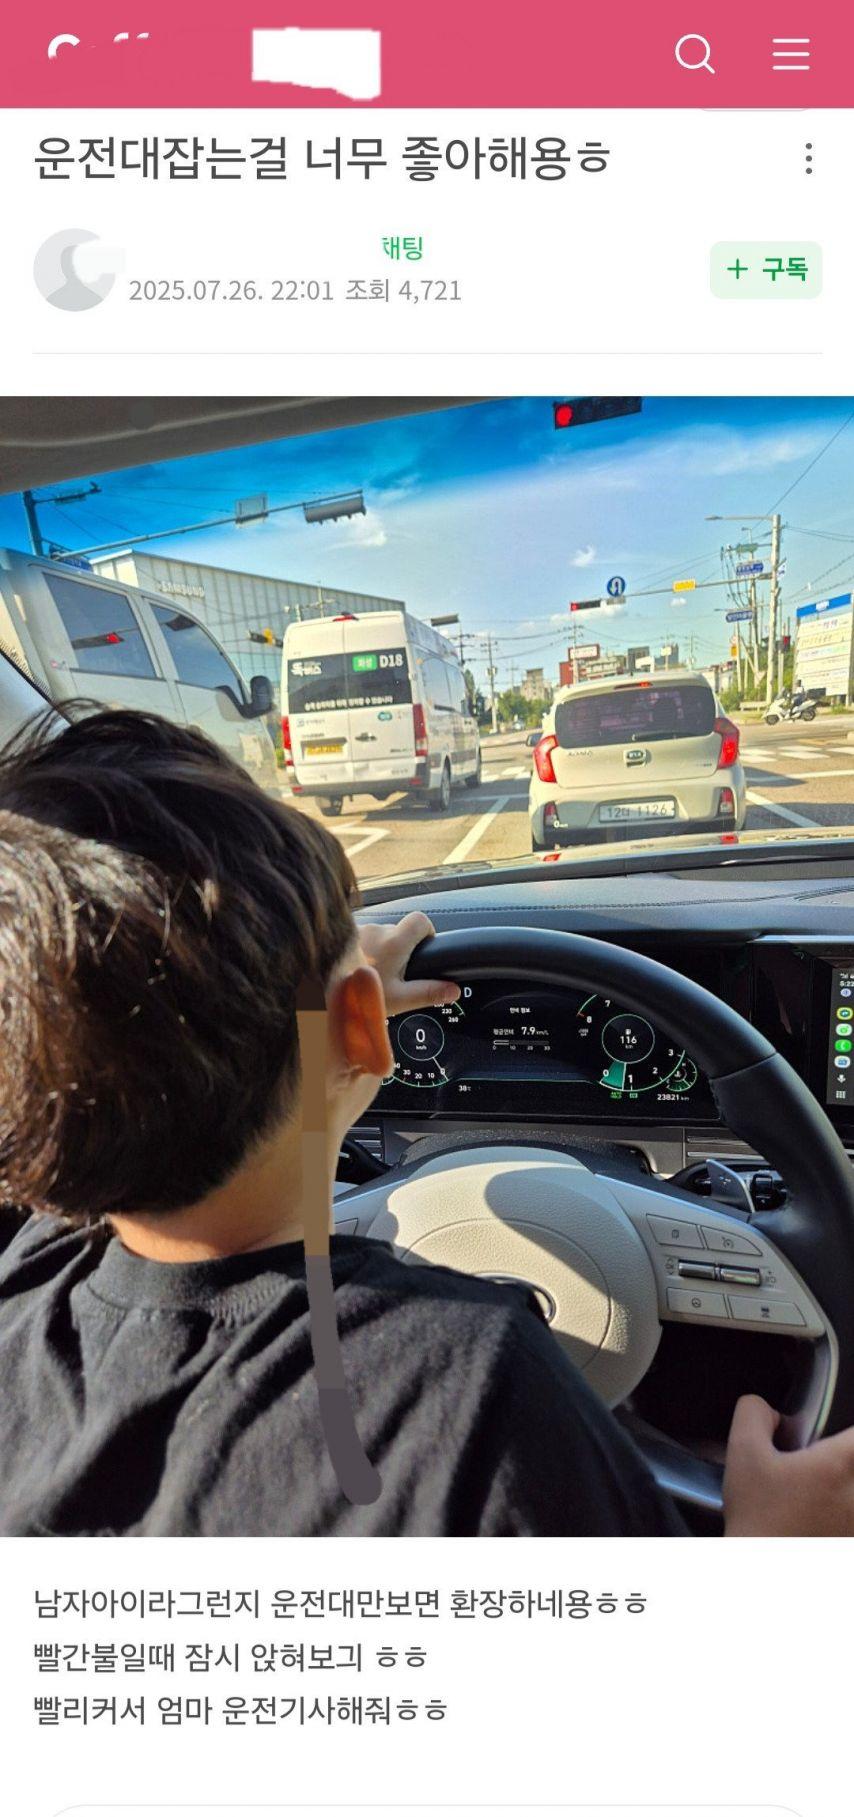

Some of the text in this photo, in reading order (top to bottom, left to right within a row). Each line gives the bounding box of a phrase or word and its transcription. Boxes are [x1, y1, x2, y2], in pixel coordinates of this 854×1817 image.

[379, 654, 403, 668] D18
[638, 799, 667, 817] 1126
[463, 986, 473, 998] D
[604, 999, 611, 1008] 7
[415, 1028, 426, 1043] 0
[619, 1035, 638, 1045] 116
[667, 1048, 674, 1057] 3
[602, 1069, 634, 1084] 0 1
[652, 1067, 659, 1075] 2
[657, 1093, 680, 1102] 23821
